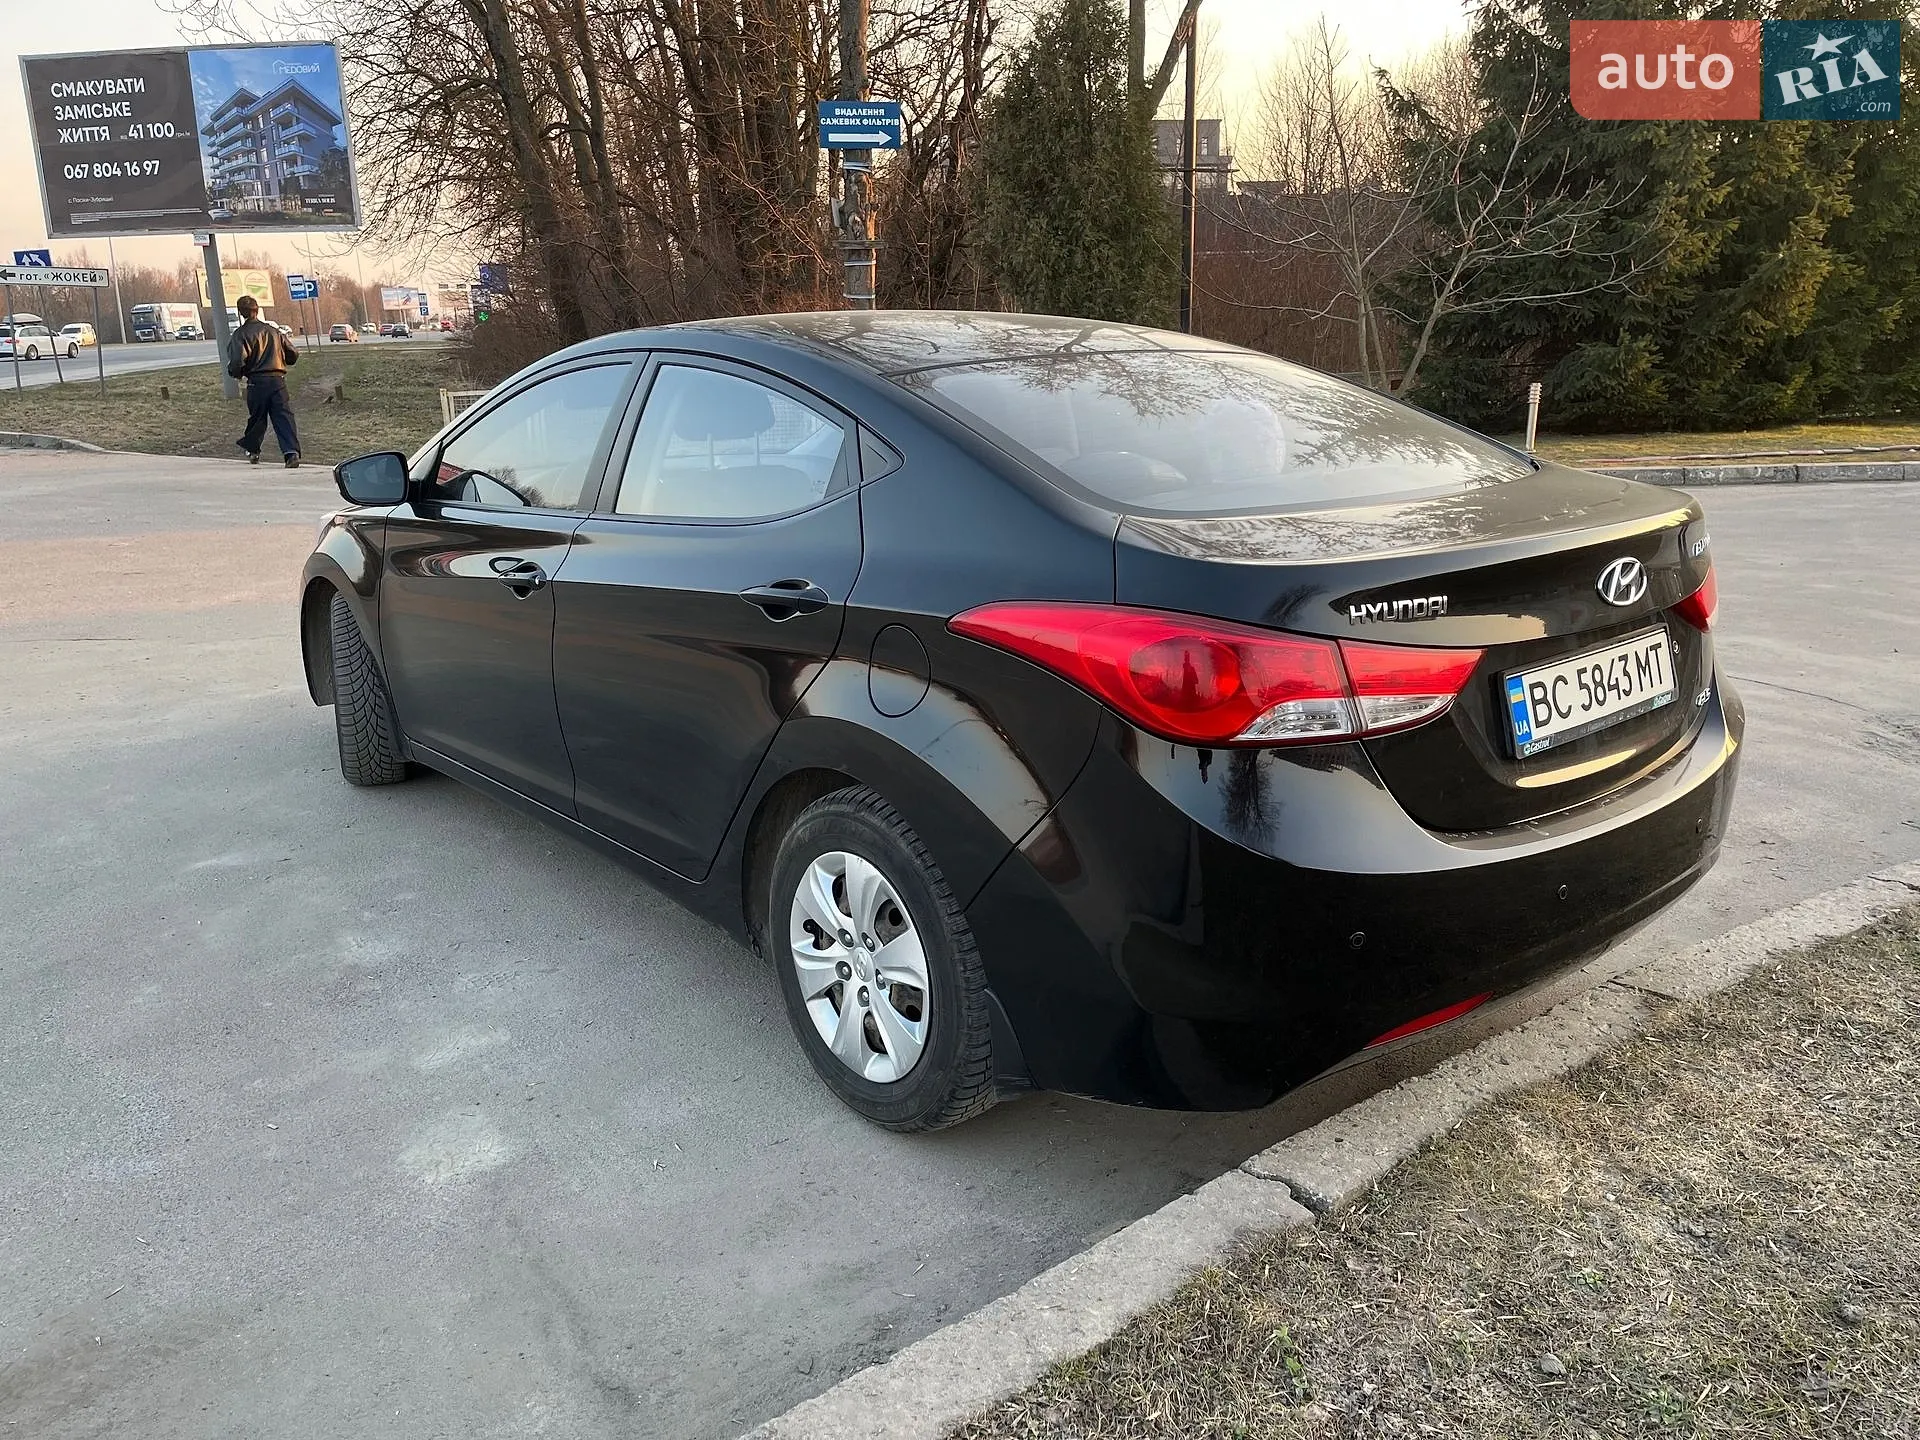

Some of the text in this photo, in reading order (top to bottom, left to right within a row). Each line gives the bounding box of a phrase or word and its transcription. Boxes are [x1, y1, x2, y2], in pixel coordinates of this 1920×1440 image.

[50, 77, 145, 98] СМАКУВАТИ
[53, 101, 132, 121] ЗАМІСЬКЕ
[834, 108, 885, 117] ВИДАЛЕННЯ
[128, 124, 144, 139] 41
[147, 122, 175, 139] 100
[820, 118, 900, 126] САЖЕВИХ ФІЛЬТРІВ
[57, 126, 111, 144] ЖИТТЯ
[63, 160, 160, 180] 067 804 16 97
[44, 271, 104, 283] «ЖОКЕЙ»
[1349, 595, 1448, 625] HYUNDAI
[1528, 674, 1573, 729] BC
[1576, 653, 1633, 712] 5843
[1634, 642, 1662, 692] MT
[1515, 720, 1530, 736] UA
